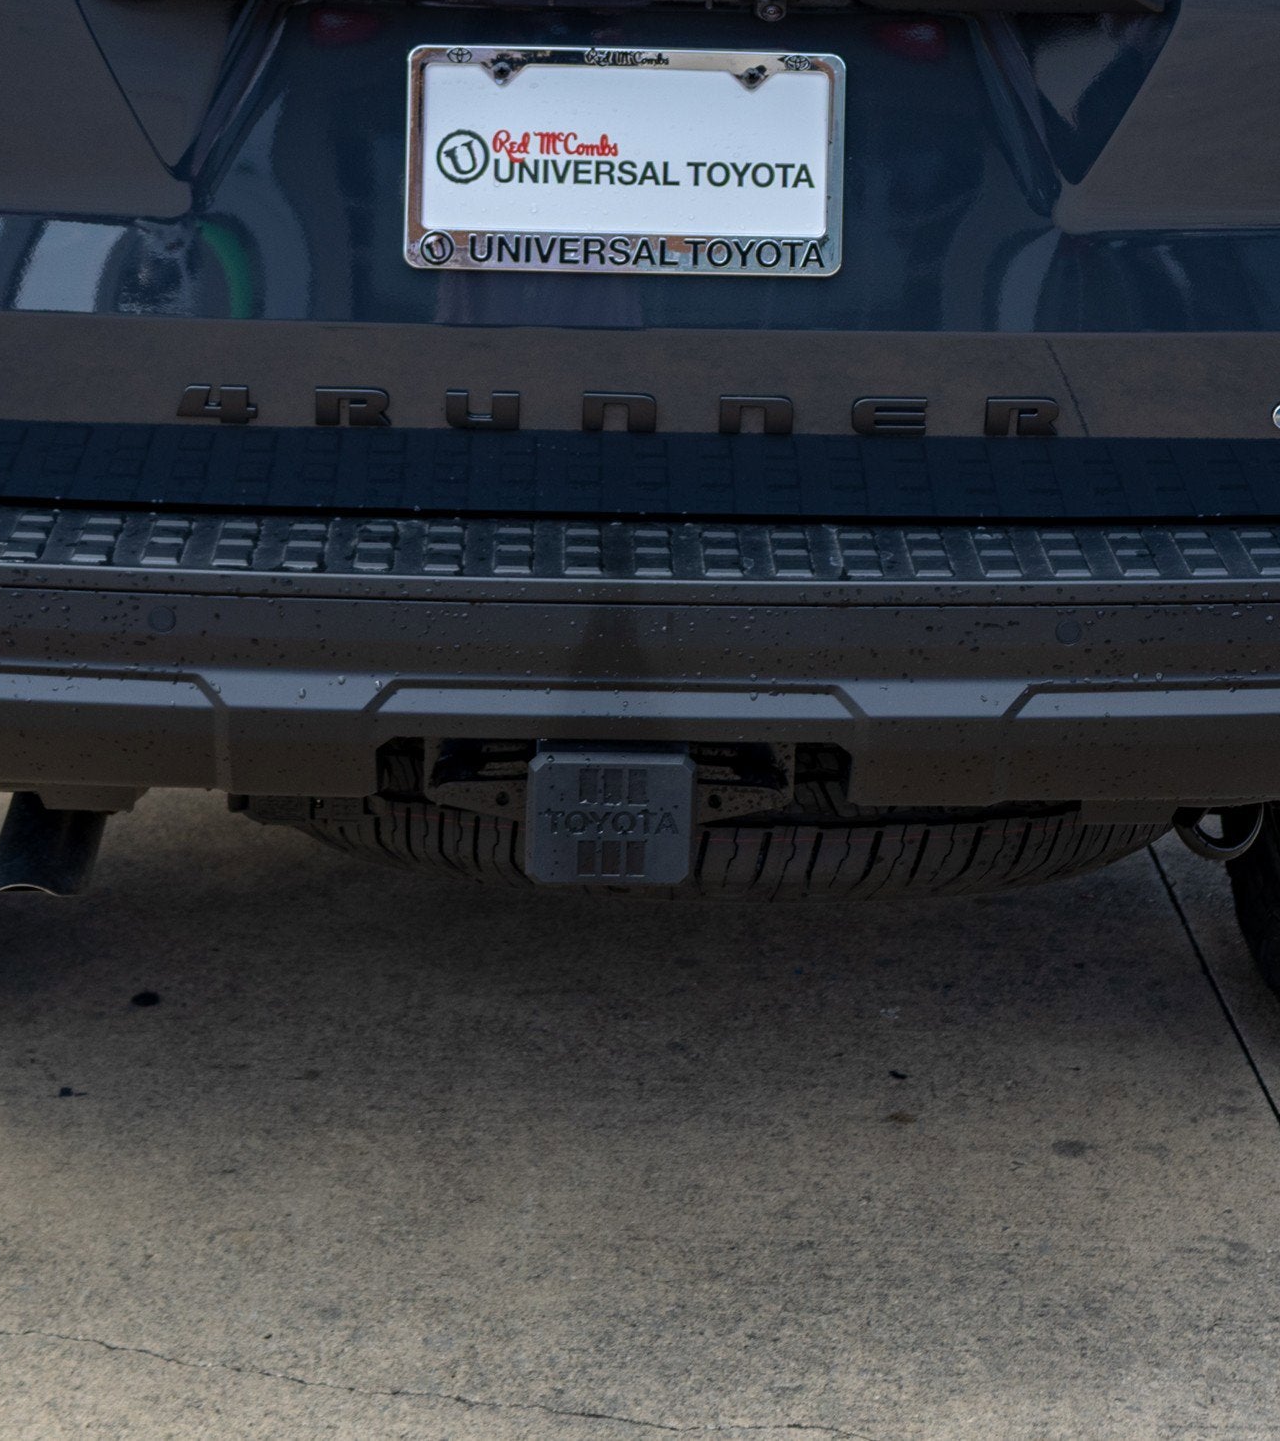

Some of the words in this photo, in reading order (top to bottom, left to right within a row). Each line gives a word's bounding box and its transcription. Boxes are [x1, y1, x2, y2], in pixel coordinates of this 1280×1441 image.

[492, 129, 530, 163] Red
[534, 131, 618, 157] McCombs
[493, 158, 679, 188] UNIVERSAL
[687, 161, 815, 189] TOYOTA
[469, 234, 677, 268] UNIVERSAL
[685, 239, 825, 268] TOYOTA
[541, 810, 679, 835] TOYOTA
